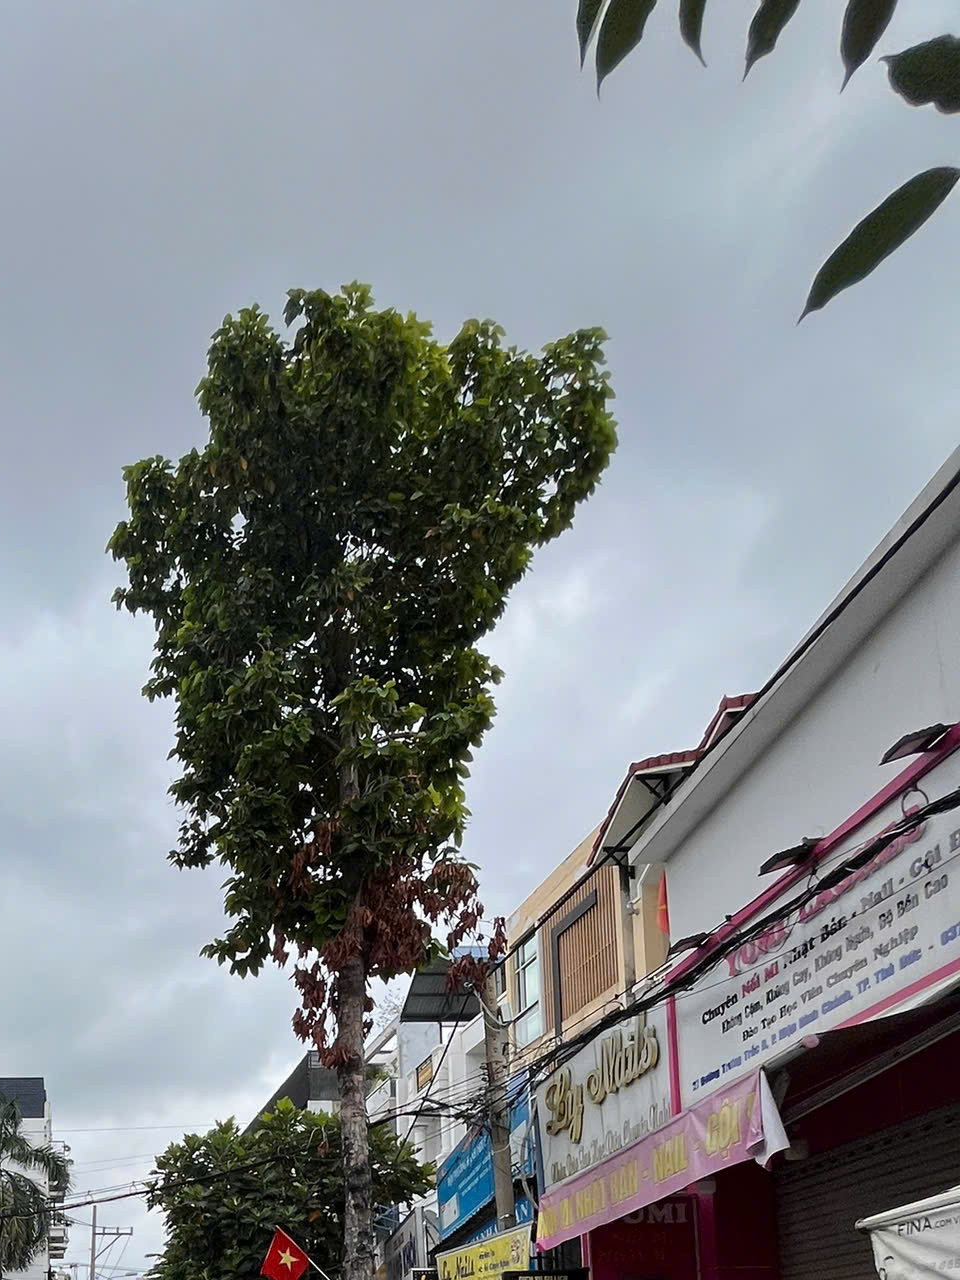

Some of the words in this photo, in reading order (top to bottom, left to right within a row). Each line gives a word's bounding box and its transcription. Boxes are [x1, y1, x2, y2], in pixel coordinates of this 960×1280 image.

[924, 874, 948, 900] Cao
[779, 1001, 798, 1019] Học
[826, 957, 868, 988] Chuyên
[702, 992, 738, 1025] Chuyên
[545, 1067, 584, 1144] Ly
[587, 1014, 661, 1105] Nails
[623, 1203, 688, 1225] UMI
